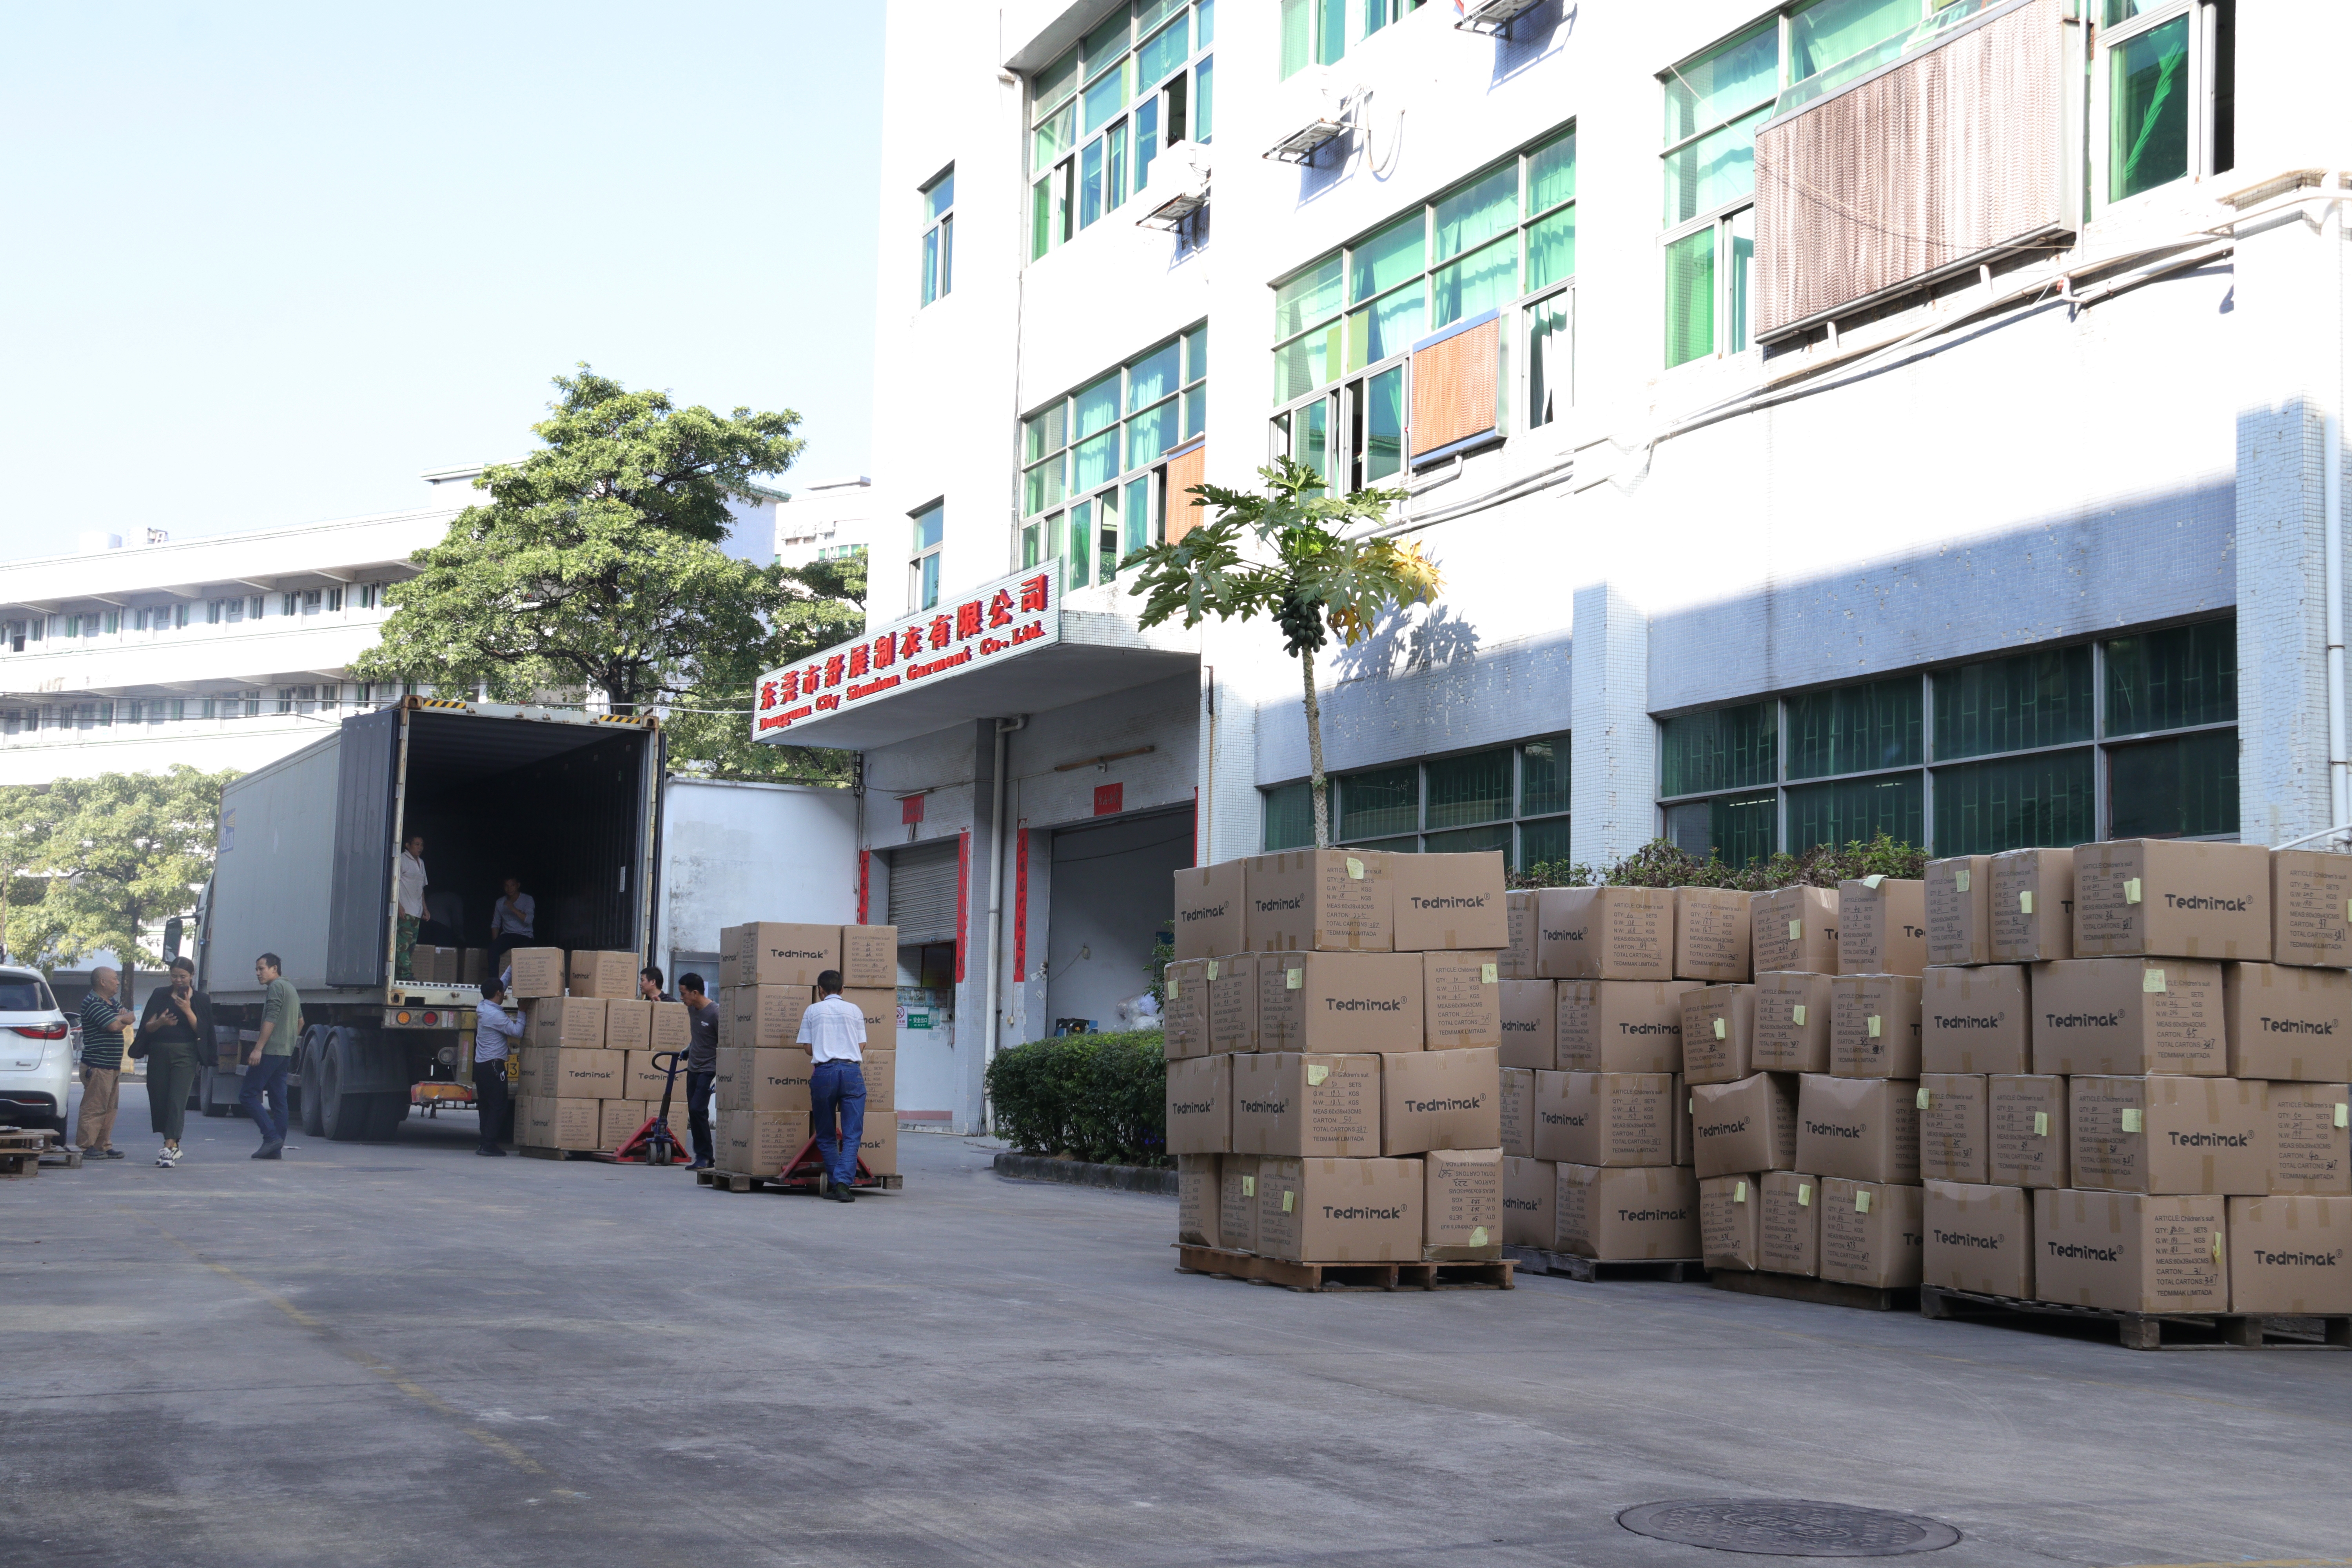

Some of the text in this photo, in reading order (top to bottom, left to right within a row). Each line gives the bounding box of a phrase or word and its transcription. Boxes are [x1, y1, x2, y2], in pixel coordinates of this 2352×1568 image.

[816, 694, 840, 710] City
[907, 646, 972, 681] Garment
[2205, 1274, 2218, 1284] 387
